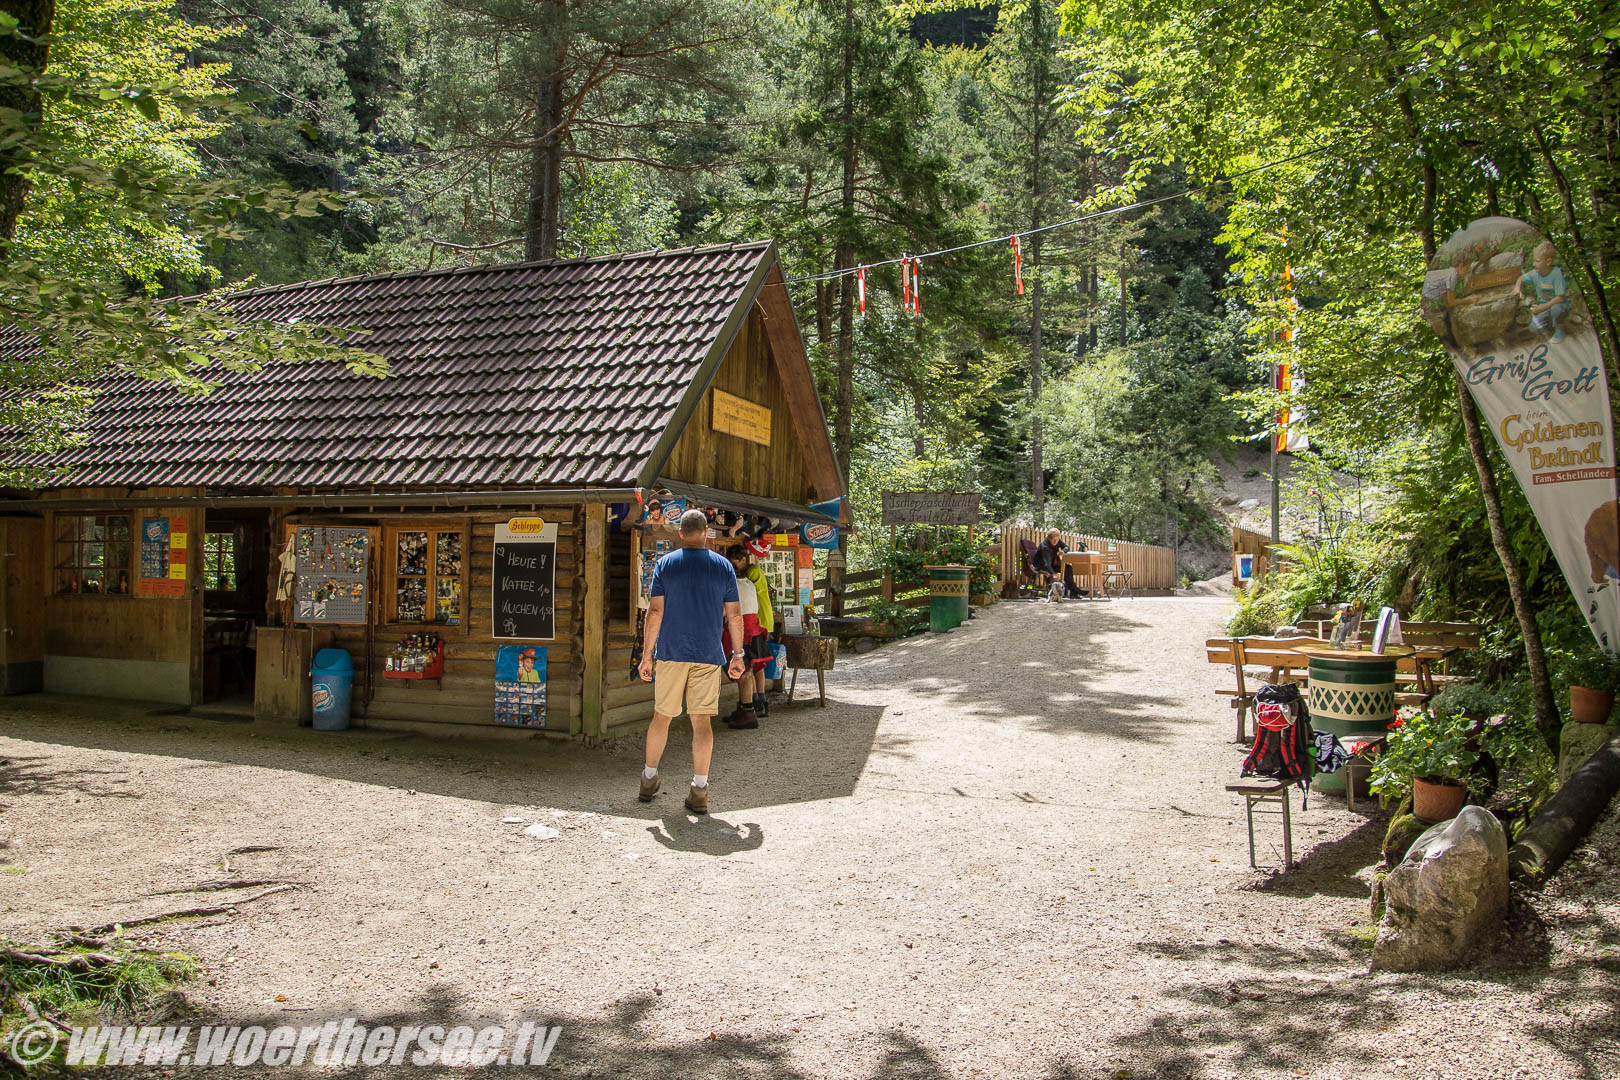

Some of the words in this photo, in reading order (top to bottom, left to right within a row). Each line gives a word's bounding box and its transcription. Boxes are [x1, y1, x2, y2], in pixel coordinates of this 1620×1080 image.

[1466, 343, 1549, 385] Grüß
[1521, 365, 1599, 401] Gott
[1526, 410, 1549, 420] beim
[1501, 414, 1603, 452] Goldenen
[1527, 441, 1604, 470] Bründl
[1535, 475, 1555, 483] Fam.
[1556, 470, 1610, 481] Schellander
[511, 520, 541, 532] Schleppe
[508, 551, 537, 569] HEUTE
[502, 600, 538, 616] KUCHEN
